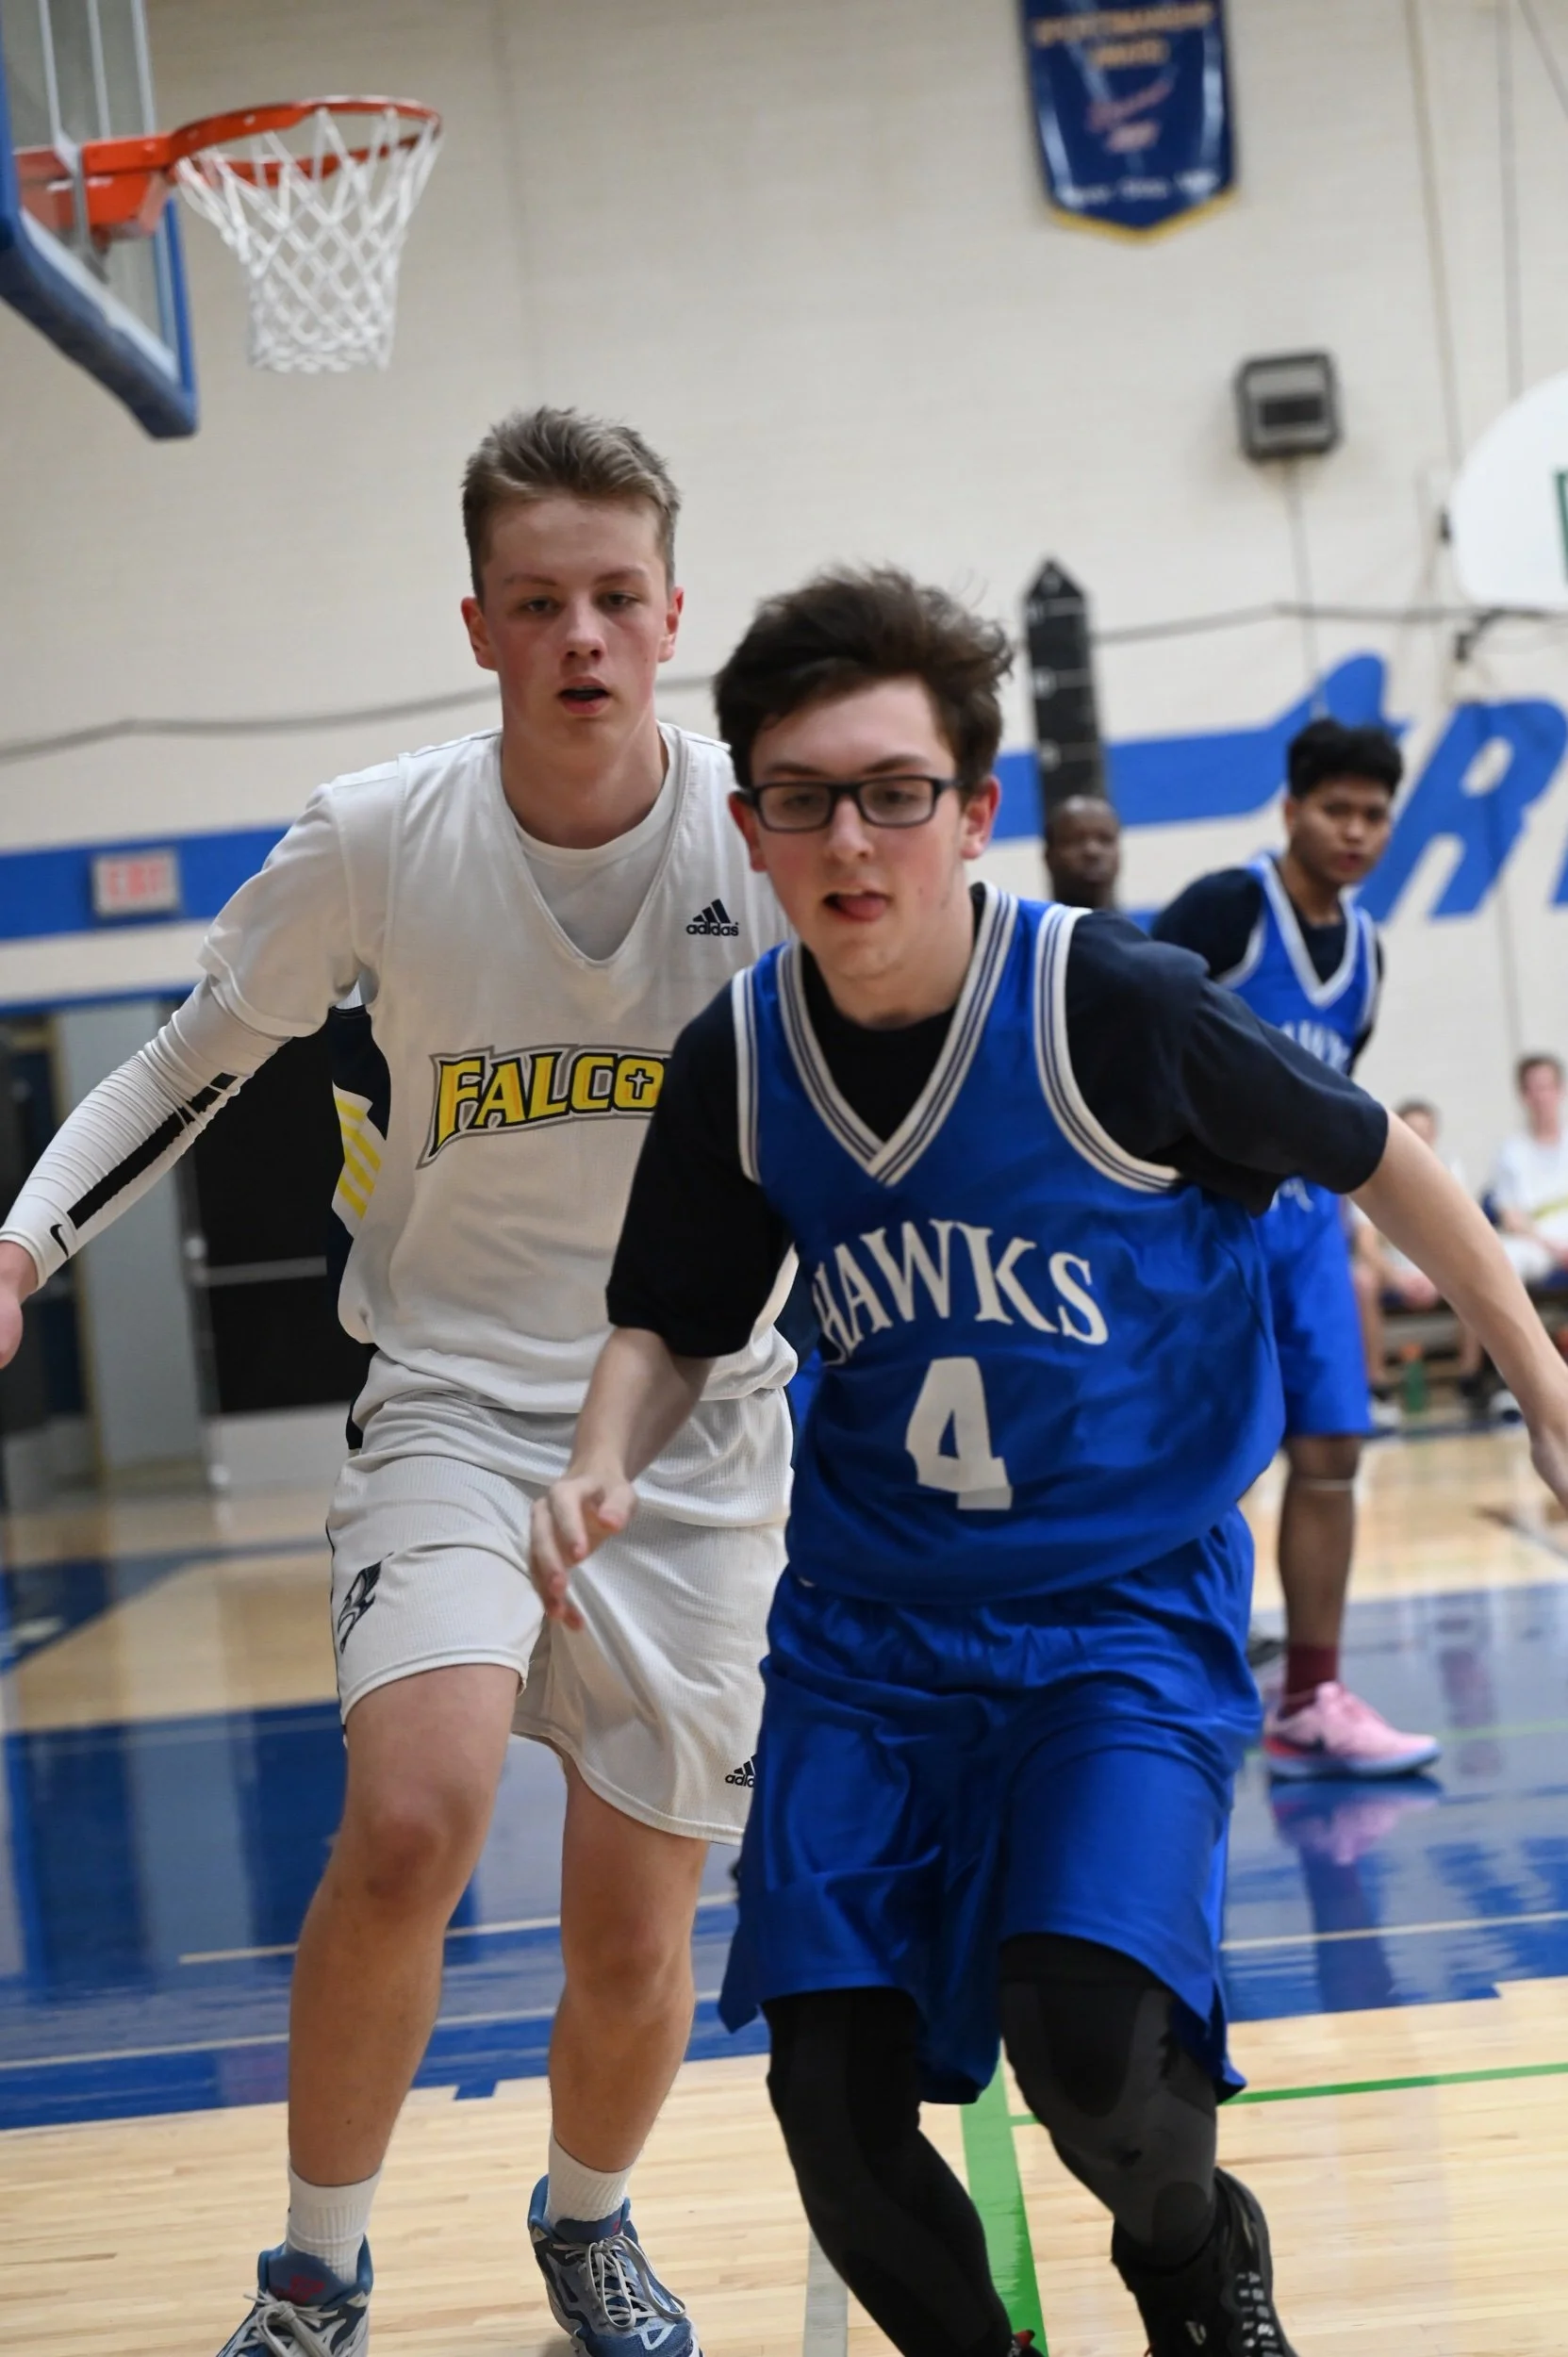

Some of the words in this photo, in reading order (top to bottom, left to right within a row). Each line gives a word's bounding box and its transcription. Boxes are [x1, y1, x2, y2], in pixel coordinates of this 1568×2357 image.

[685, 921, 739, 936] adidas
[812, 1218, 1109, 1366] HAWKS
[904, 1356, 1013, 1510] 4
